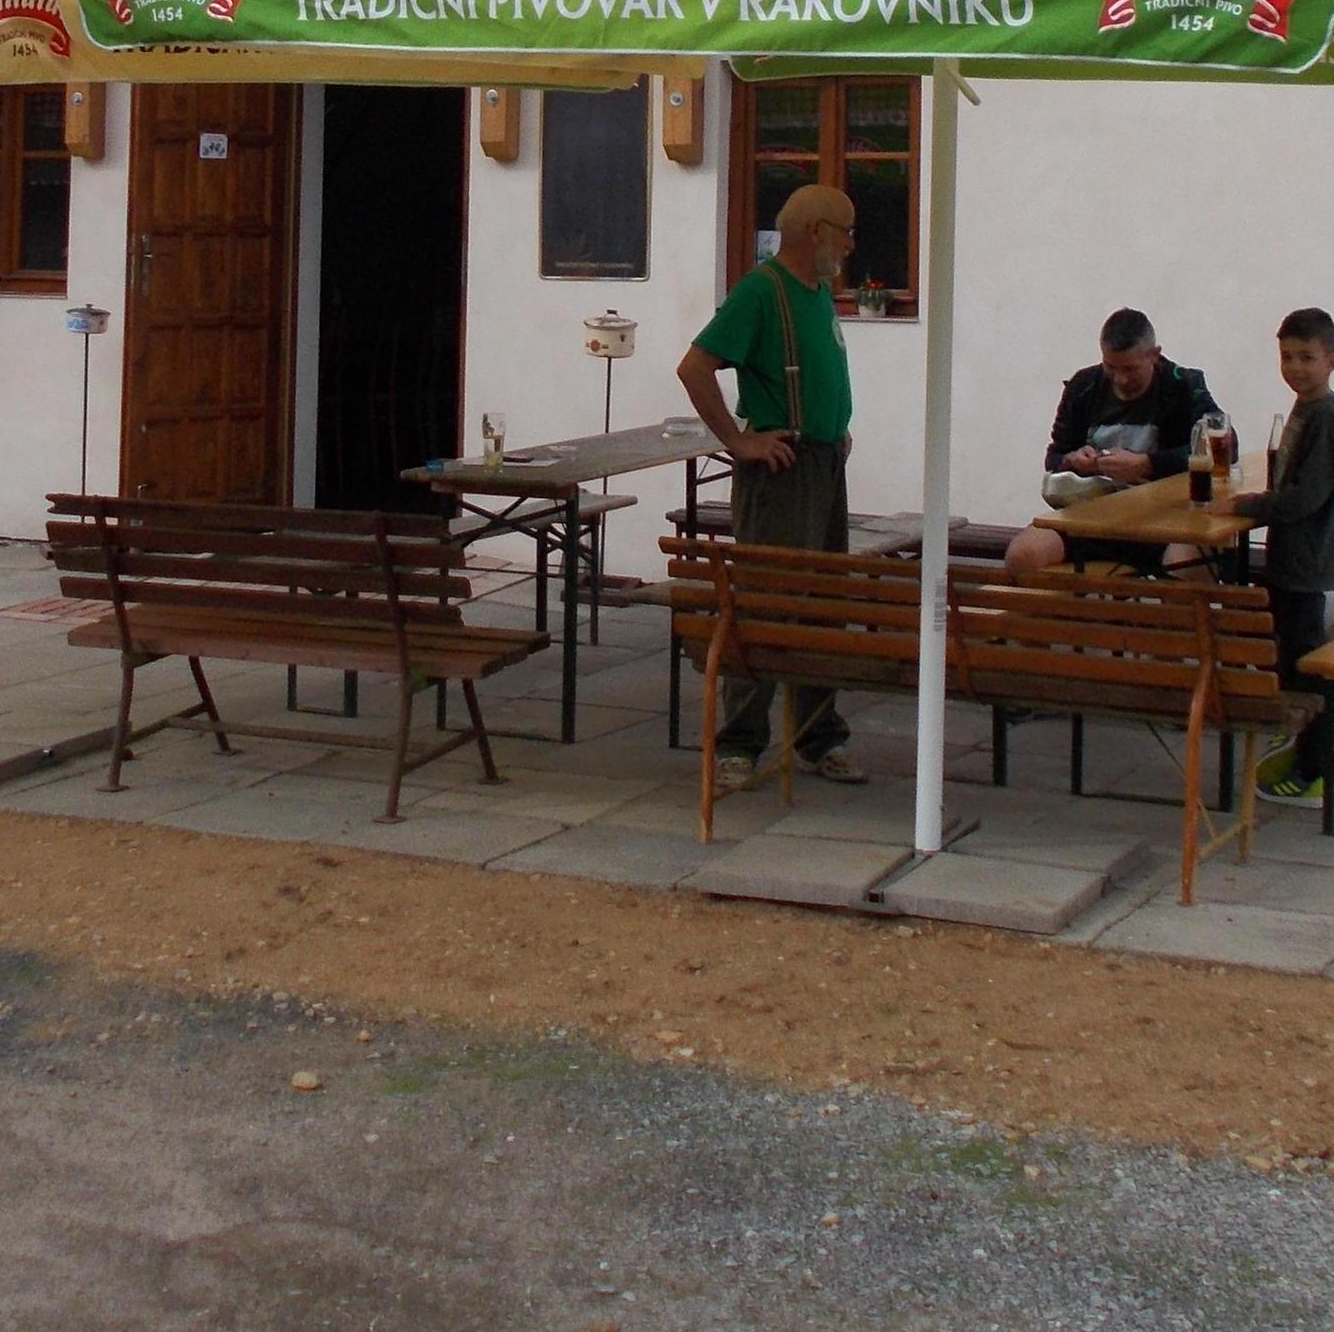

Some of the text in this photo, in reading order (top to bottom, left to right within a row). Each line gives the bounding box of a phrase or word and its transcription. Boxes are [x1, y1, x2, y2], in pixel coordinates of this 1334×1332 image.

[151, 7, 183, 22] 1454
[1215, 0, 1244, 16] PIVO
[1170, 14, 1215, 31] 1454
